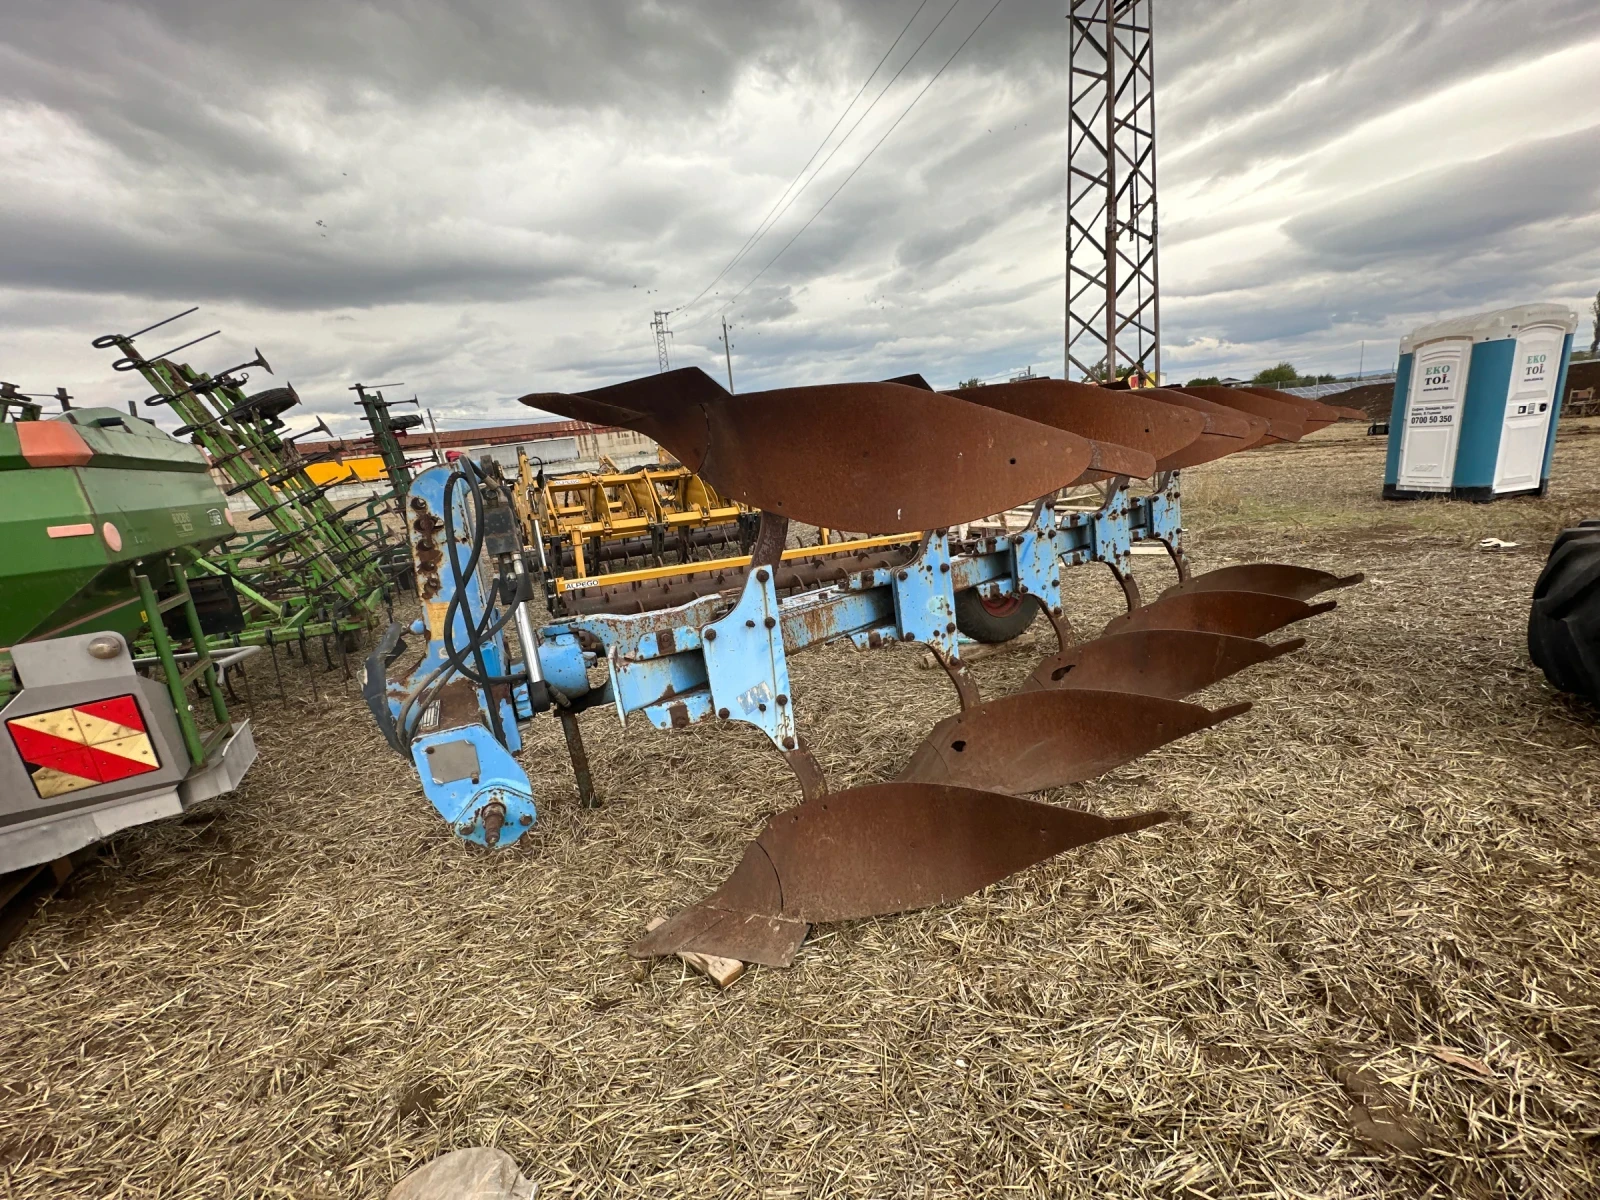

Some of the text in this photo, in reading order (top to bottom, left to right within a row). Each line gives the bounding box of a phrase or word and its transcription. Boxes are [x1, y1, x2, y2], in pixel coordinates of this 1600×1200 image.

[1526, 354, 1546, 364] EKO
[1425, 364, 1451, 376] EKO
[1411, 414, 1452, 424] 0700 50 350
[566, 580, 599, 589] ALPEGO
